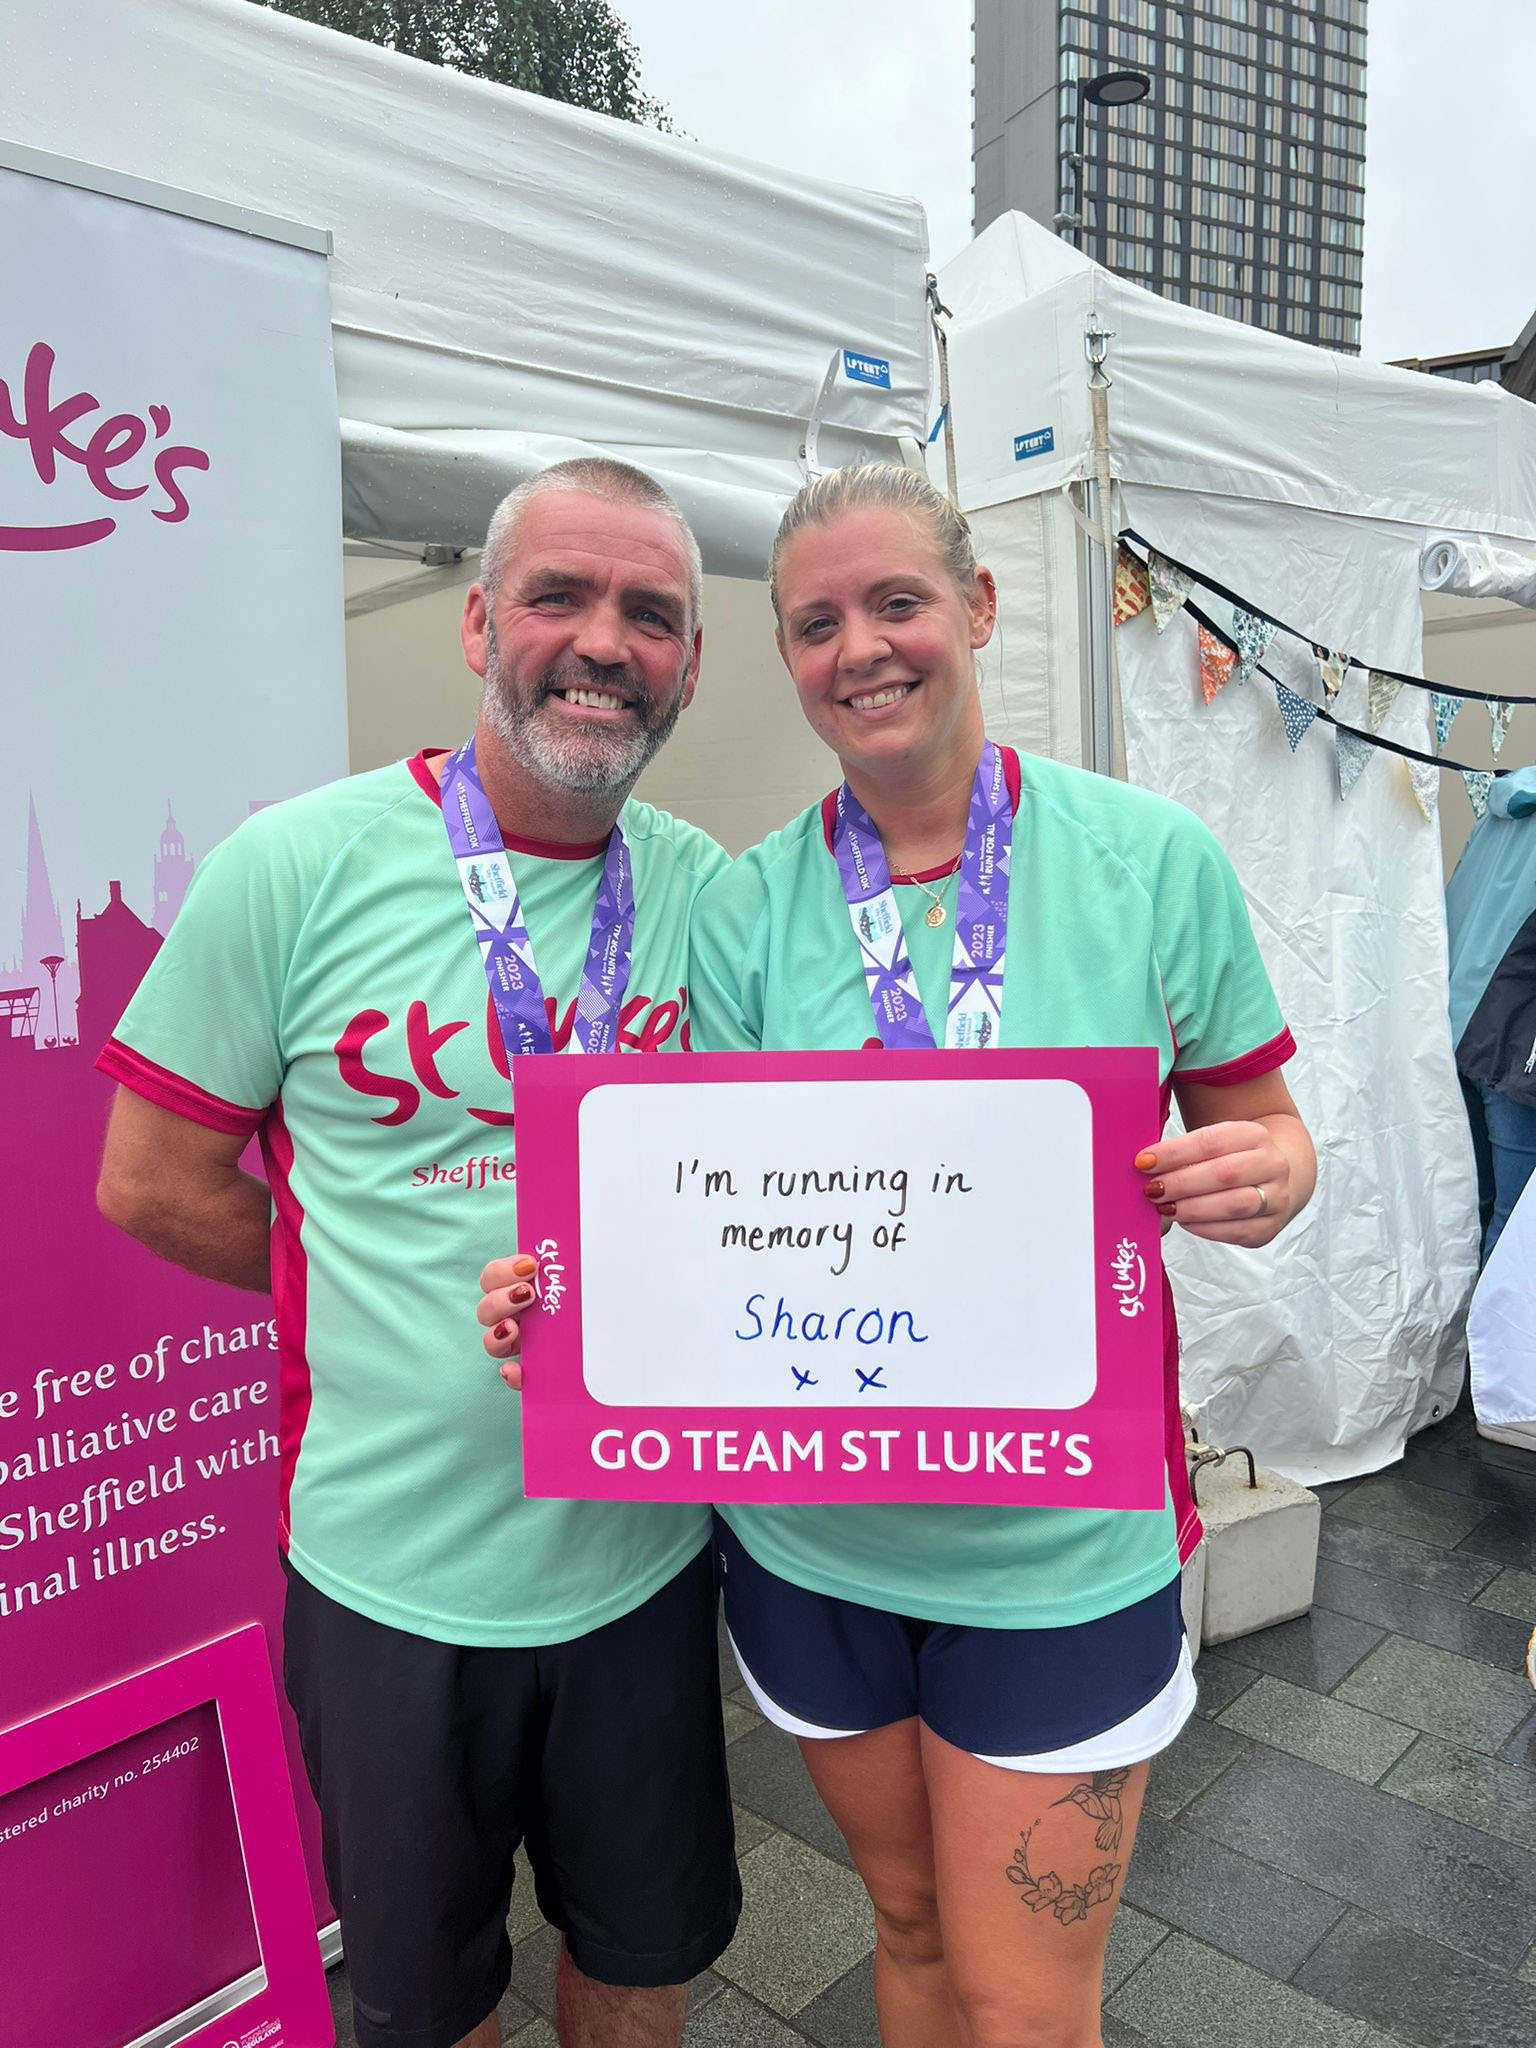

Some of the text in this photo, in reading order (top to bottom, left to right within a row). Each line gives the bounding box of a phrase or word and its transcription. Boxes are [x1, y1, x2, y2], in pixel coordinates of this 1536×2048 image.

[992, 756, 1003, 792] SHEFFIELD
[458, 792, 480, 849] SHEFFIELD 10K
[849, 840, 871, 890] SHEFFIELD 10K
[985, 823, 996, 874] RUN FOR ALL
[490, 864, 509, 899] Sheffield
[879, 899, 894, 934] Sheffield
[971, 923, 985, 958] 2023
[607, 924, 622, 976] RUN FOR ALL
[985, 925, 995, 959] FINISHER
[494, 956, 510, 992] FINISHER
[504, 954, 524, 991] 2023
[880, 989, 895, 1024] FINISHER
[890, 987, 908, 1021] 2023
[587, 1020, 604, 1053] 2023
[334, 1000, 470, 1126] St
[675, 1159, 973, 1216] I'm running in
[721, 1222, 908, 1276] memory of
[536, 1239, 567, 1316] St Luke's
[1110, 1238, 1144, 1317] St Luke's
[735, 1293, 928, 1345] Sharon
[33, 1363, 117, 1419] free
[128, 1335, 174, 1383] of
[189, 1380, 269, 1423] care
[590, 1428, 1094, 1477] GO TEAM ST LUKE'S
[0, 1429, 281, 1550] Sheffield with
[92, 1514, 227, 1581] illness.
[53, 1781, 110, 1817] charity
[114, 1769, 138, 1788] no.
[142, 1736, 200, 1775] 254402
